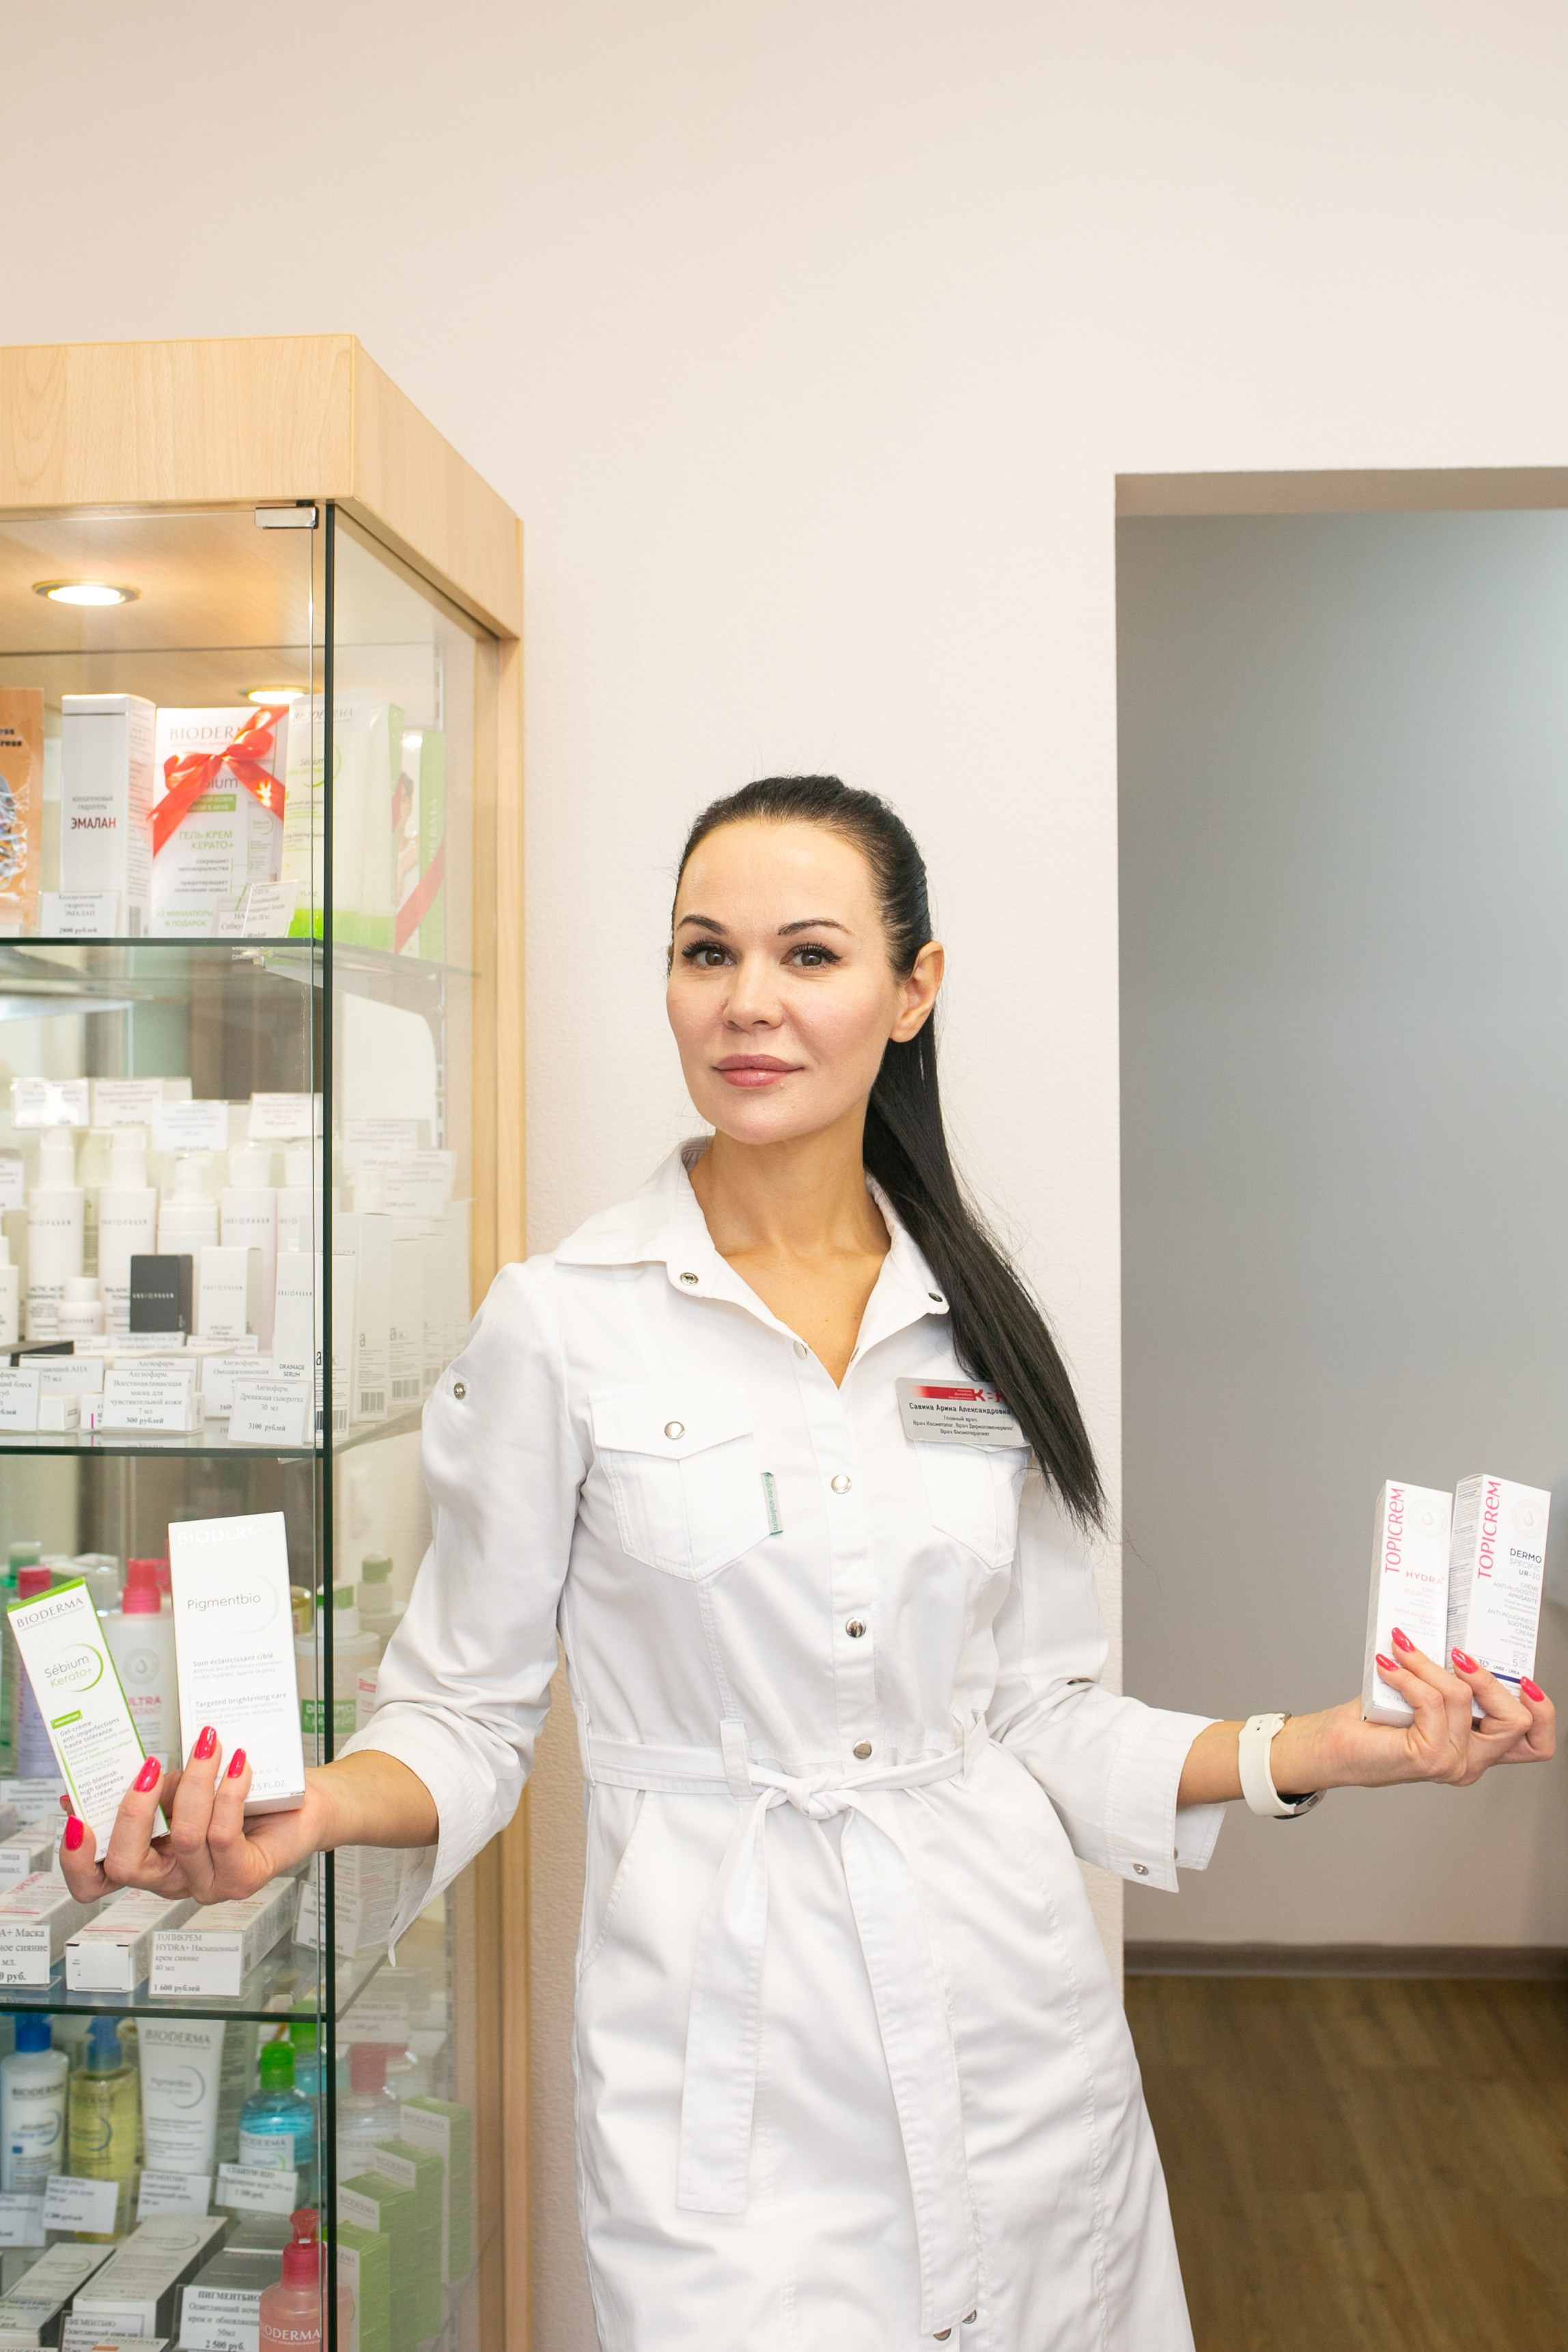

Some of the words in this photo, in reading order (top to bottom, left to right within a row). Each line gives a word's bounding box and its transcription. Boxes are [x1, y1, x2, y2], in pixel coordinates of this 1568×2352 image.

[170, 726, 241, 740] BIODER
[71, 817, 117, 830] ЭМАЛАН
[179, 830, 233, 841] ГЕЛЬ-КРЕМ
[191, 841, 234, 850] КЕРАТО+
[128, 1371, 169, 1379] Ангиофарм.
[255, 1384, 290, 1393] Ангиофарм.
[240, 1393, 272, 1401] Дренажная
[909, 1403, 934, 1411] Савина
[959, 1406, 1011, 1415] Александровна
[139, 1417, 164, 1425] рублей
[1510, 1548, 1542, 1563] DERMO
[1509, 1558, 1541, 1572] SPECIFIC
[1519, 1569, 1541, 1580] UR-30
[187, 1593, 261, 1612] Pigmentbio
[1508, 1592, 1537, 1604] APAISANTE
[16, 1597, 84, 1628] BIODERMA
[1487, 1608, 1536, 1625] ANTI-ROUGHNESS
[1507, 1619, 1535, 1632] SOOTHING
[1515, 1628, 1535, 1638] CREAM
[210, 1655, 255, 1665] éclaircissant
[1512, 1658, 1518, 1667] 5
[44, 1655, 89, 1678] Sébium
[49, 1668, 93, 1688] Kerato+
[195, 1699, 227, 1708] Targeted
[228, 1694, 270, 1705] brightening
[59, 1721, 92, 1737] Gel-crème
[62, 1718, 120, 1744] anti-imperfections
[64, 1737, 83, 1750] haute
[83, 1728, 113, 1744] tolérance
[78, 1770, 117, 1790] Anti-blemish
[80, 1787, 94, 1797] high
[95, 1775, 125, 1791] tolerance
[82, 1787, 114, 1804] gel-cream
[16, 1928, 45, 1937] Маска
[7, 1973, 27, 1983] руб.
[174, 1985, 200, 1993] рублей
[198, 2291, 260, 2302] ПИГМЕНТБИО
[188, 2303, 239, 2313] Осветляющий
[217, 2328, 236, 2337] 50мл
[206, 2340, 210, 2349] 2
[212, 2340, 226, 2349] 500
[228, 2341, 245, 2352] руб.
